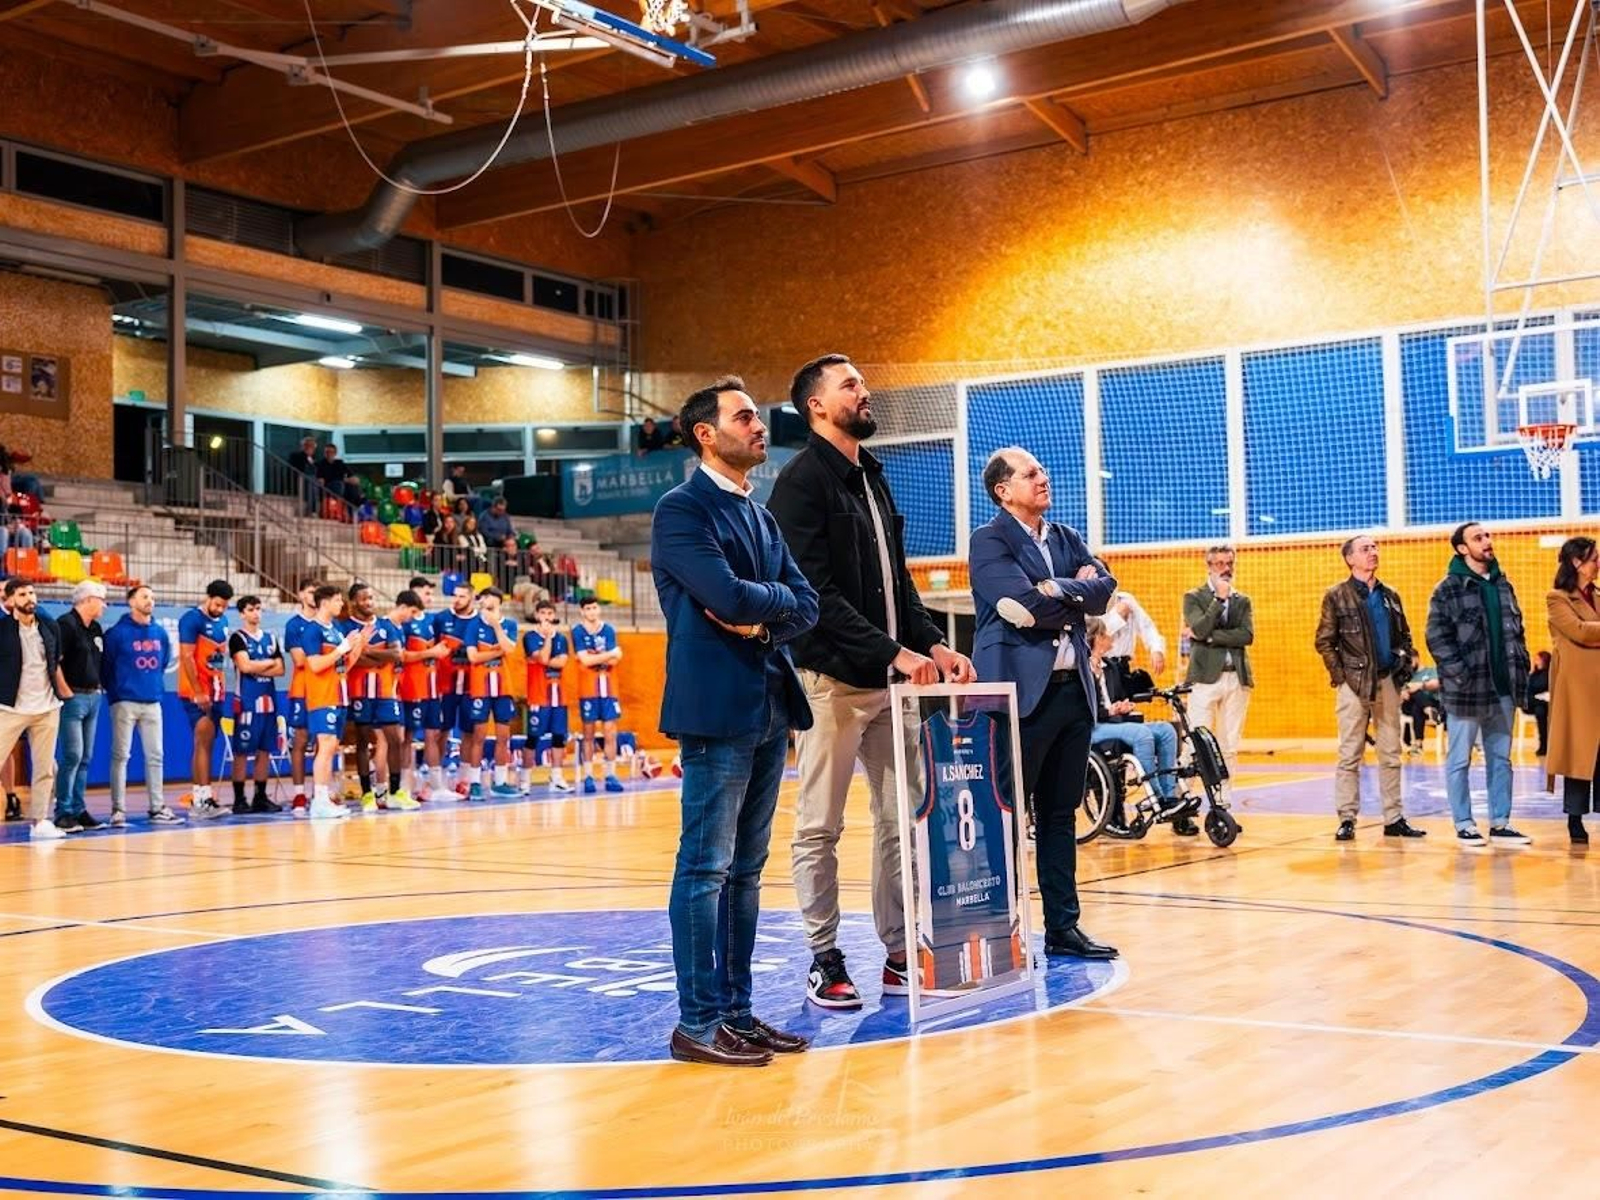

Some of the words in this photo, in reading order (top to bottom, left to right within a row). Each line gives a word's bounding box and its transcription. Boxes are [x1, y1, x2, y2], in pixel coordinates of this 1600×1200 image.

[596, 470, 674, 490] MARBELLA
[942, 760, 985, 782] A.SÁNCHEZ
[957, 789, 976, 851] 8
[937, 883, 956, 897] CLUB
[956, 892, 990, 906] MARBELLA
